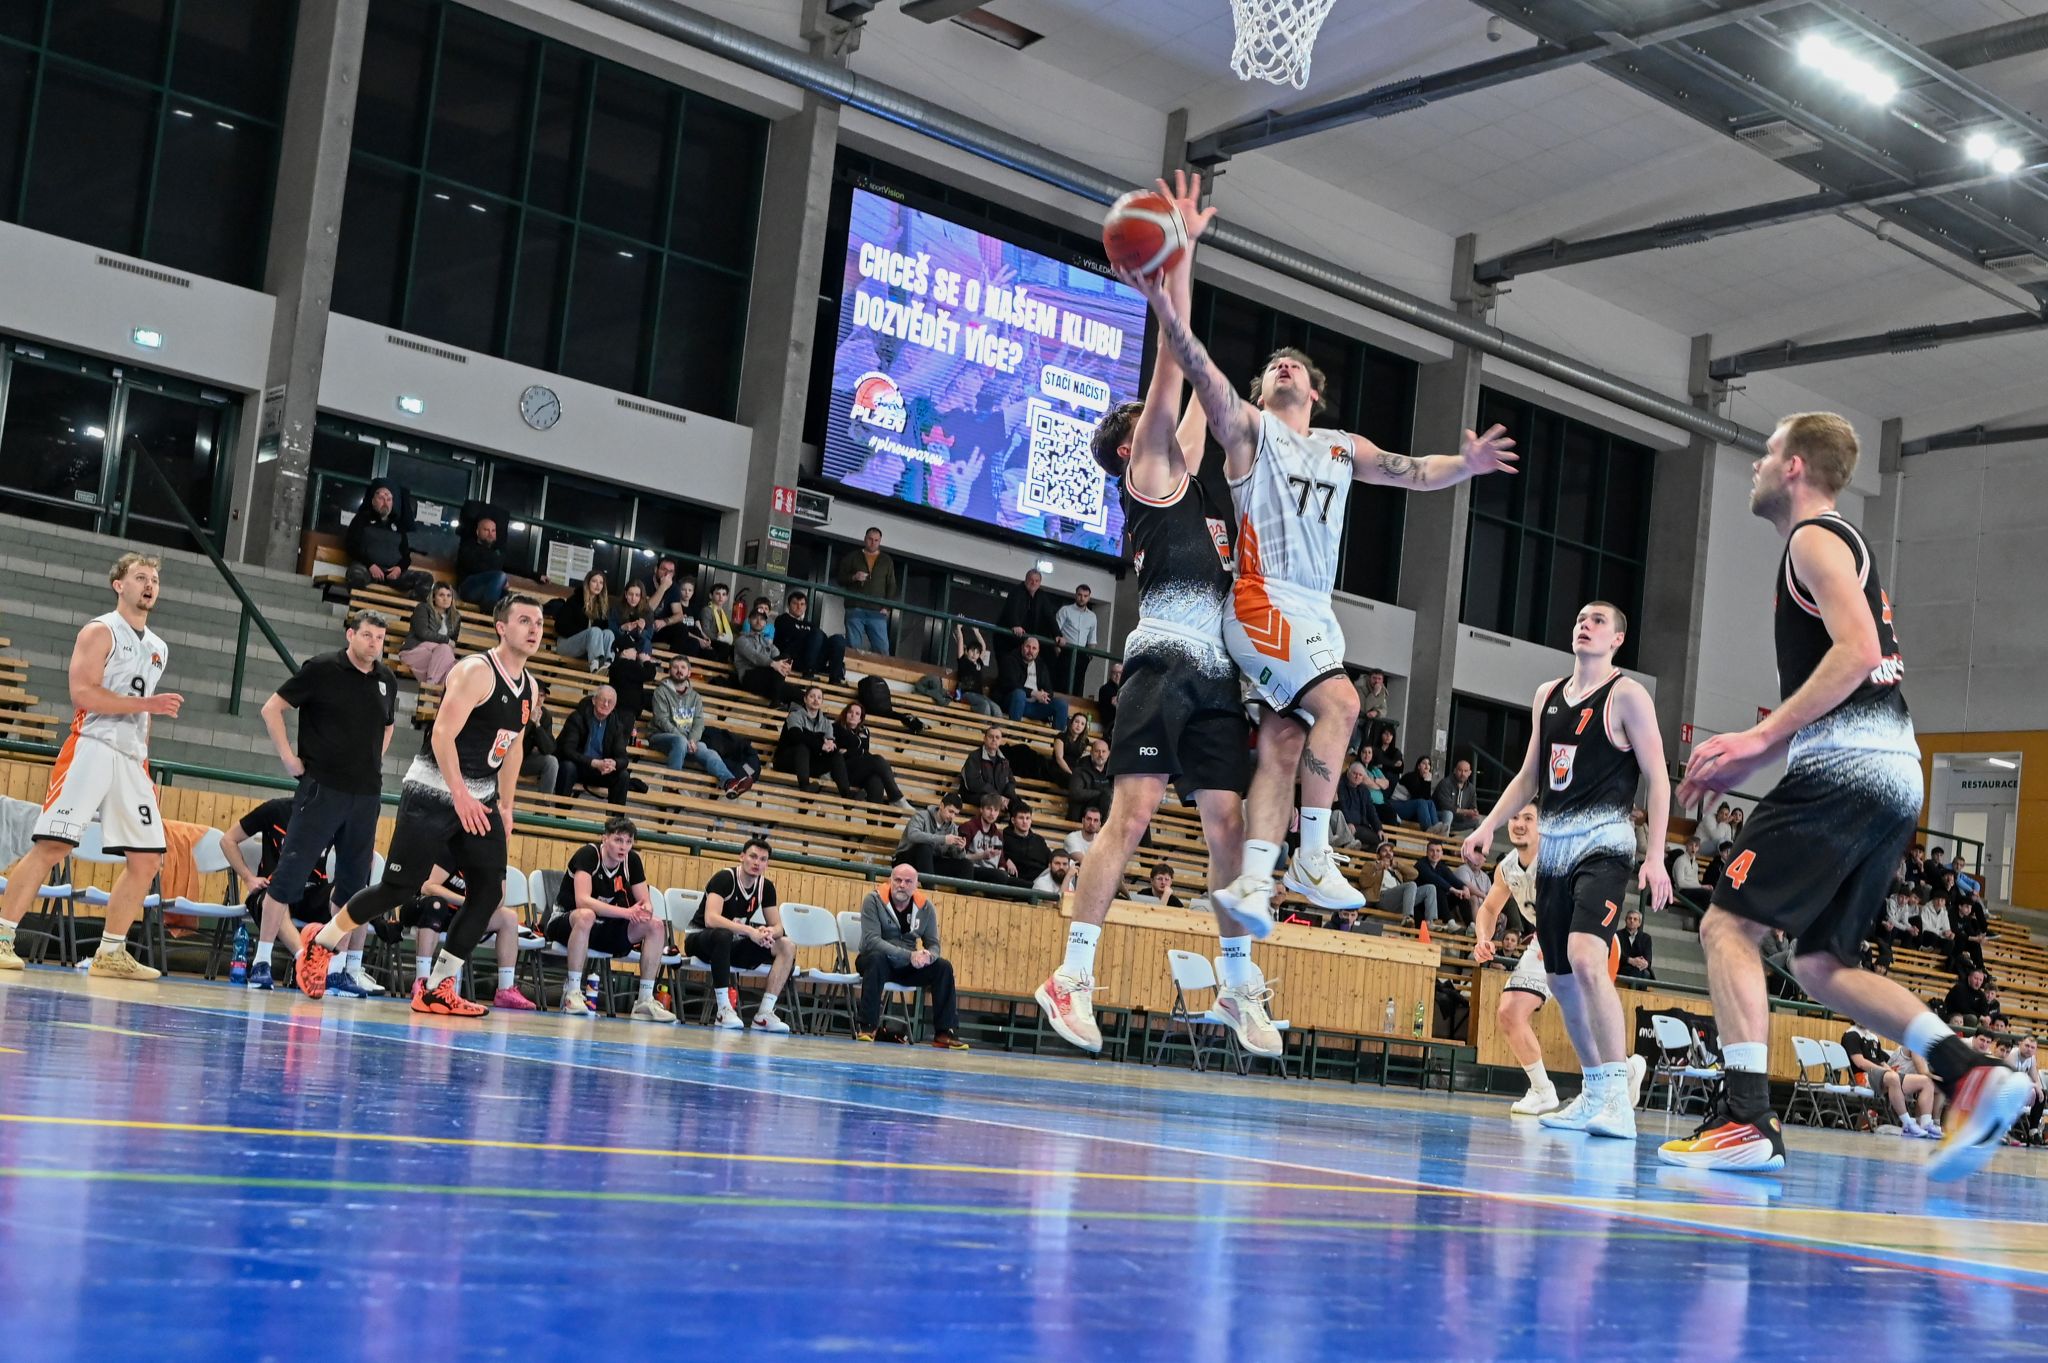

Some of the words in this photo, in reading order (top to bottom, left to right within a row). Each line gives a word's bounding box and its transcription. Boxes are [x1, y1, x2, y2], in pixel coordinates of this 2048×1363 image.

[858, 242, 931, 295] CHCEŠ
[933, 267, 961, 307] SE
[964, 278, 981, 312] O
[984, 284, 1058, 339] NAŠEM
[1060, 310, 1123, 360] KLUBU
[853, 290, 960, 355] DOZVĚDĚT
[965, 324, 1023, 374] VÍCE?
[1045, 371, 1071, 391] STAČÍ
[1287, 473, 1337, 525] 77
[1961, 780, 2018, 789] RESTAURACE
[138, 804, 152, 825] 9
[1725, 848, 1757, 890] 4
[1601, 899, 1618, 928] 7
